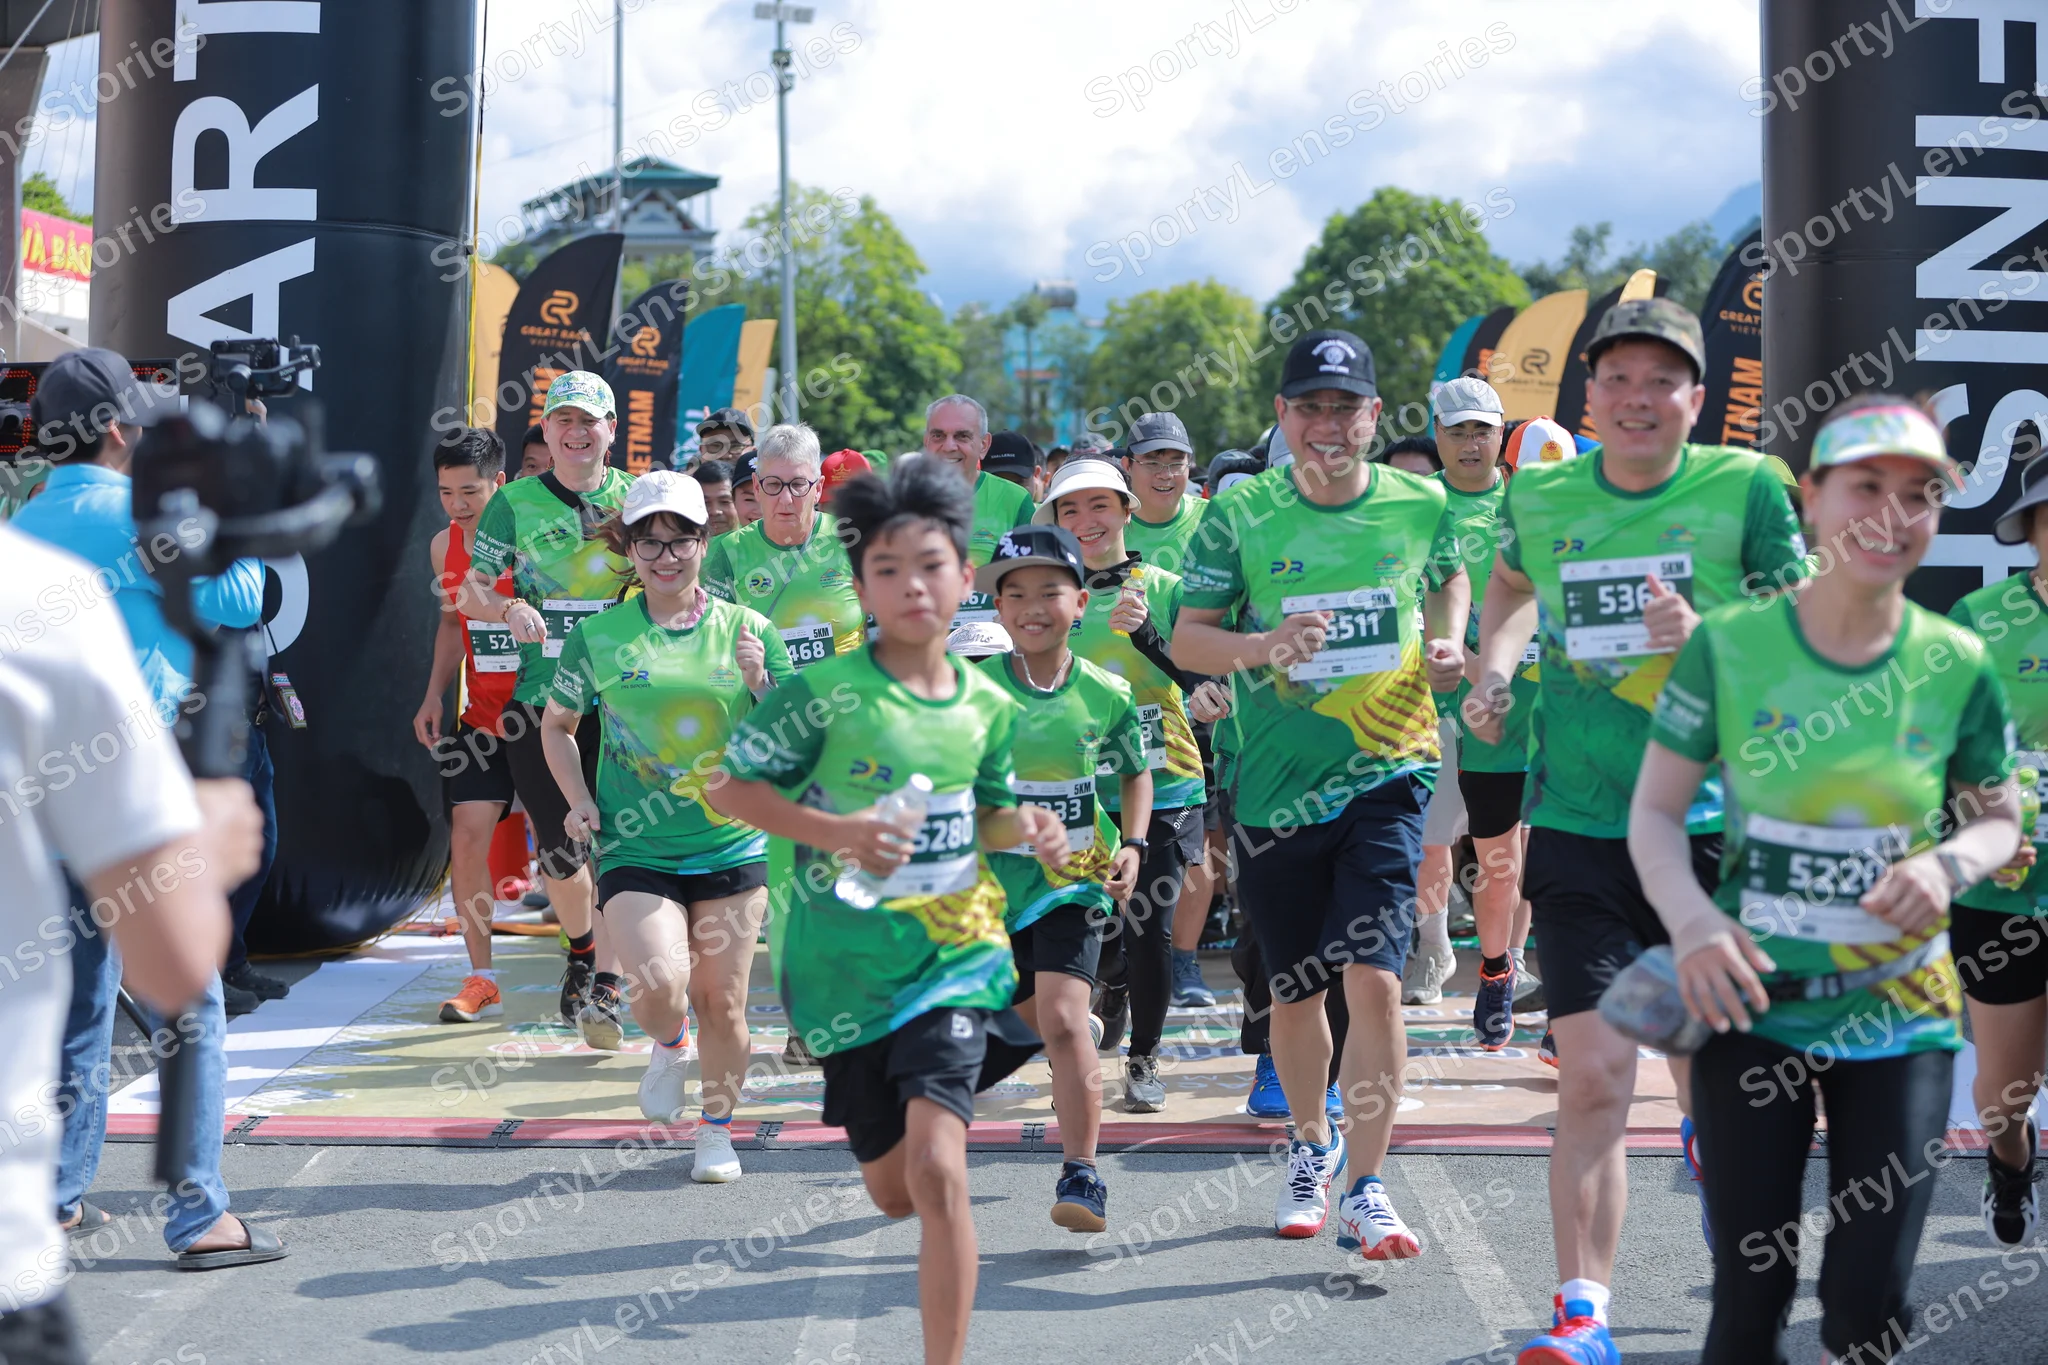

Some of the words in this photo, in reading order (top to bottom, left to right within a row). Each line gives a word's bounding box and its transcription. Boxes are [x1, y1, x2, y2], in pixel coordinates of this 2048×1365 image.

[521, 325, 559, 338] GREAT
[1721, 356, 1762, 447] TNAM
[626, 390, 655, 475] ETNAM
[1661, 561, 1684, 576] 5KM
[813, 626, 830, 639] 5KM
[489, 634, 519, 650] 521
[788, 640, 826, 662] 468
[1143, 708, 1159, 721] 5KM
[1074, 781, 1092, 796] 5KM
[1022, 799, 1081, 822] 33
[914, 814, 973, 854] 5280
